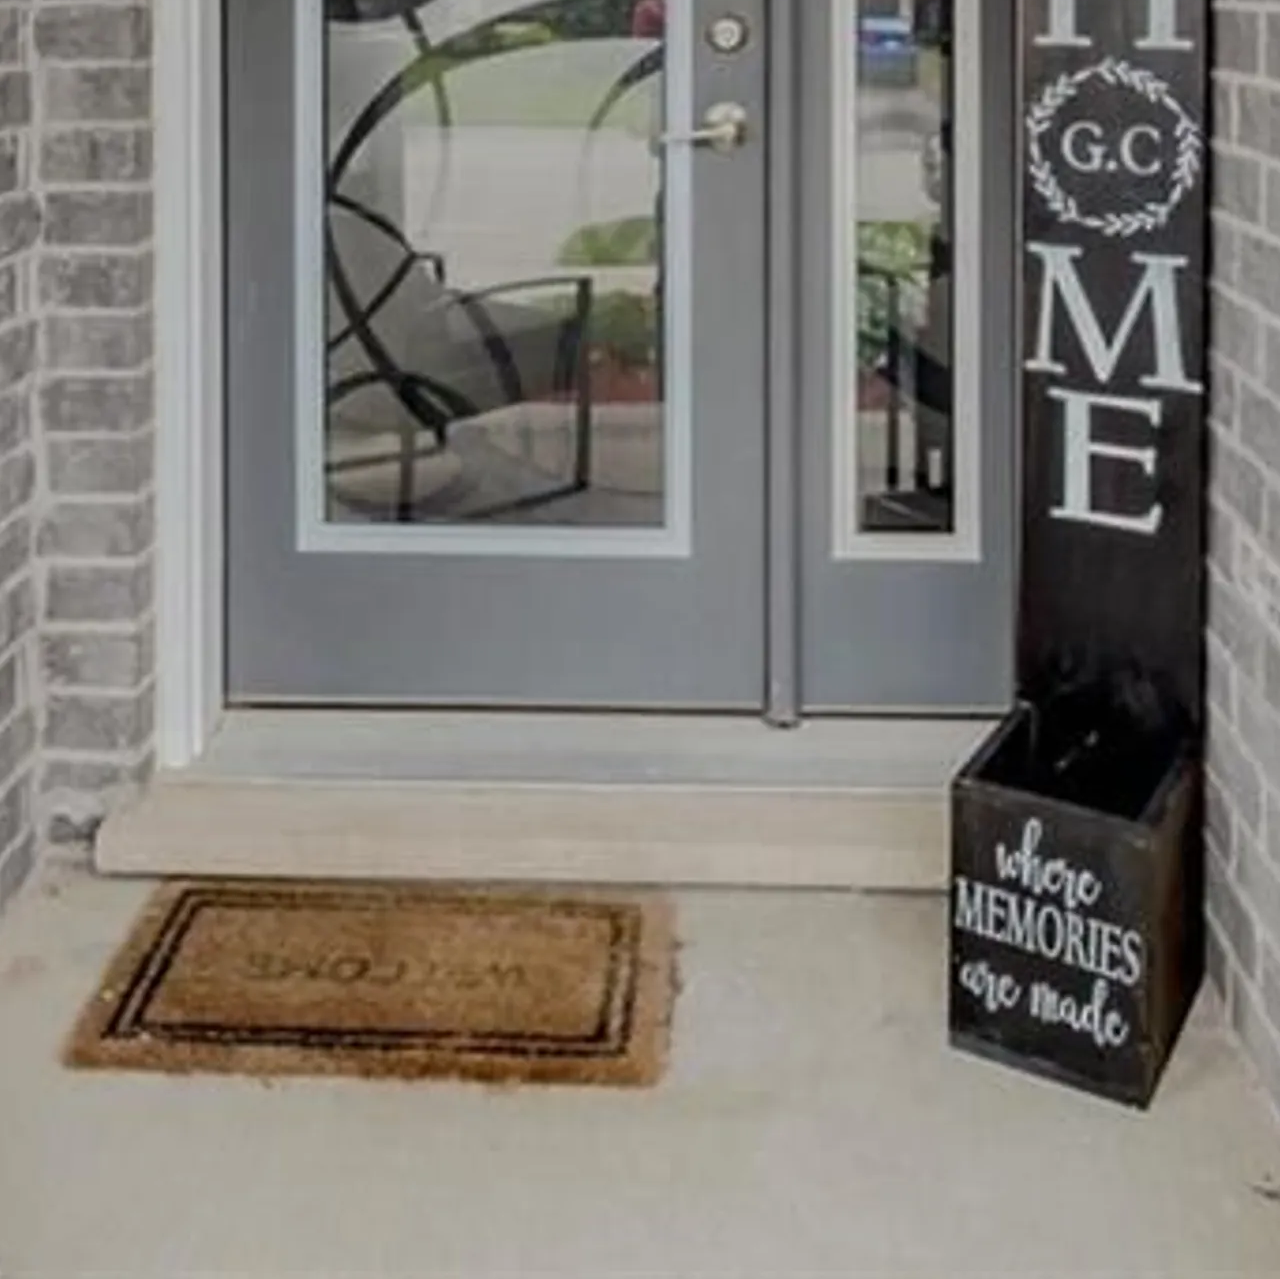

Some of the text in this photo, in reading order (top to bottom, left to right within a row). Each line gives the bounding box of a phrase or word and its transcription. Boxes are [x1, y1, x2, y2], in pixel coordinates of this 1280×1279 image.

[1060, 121, 1163, 176] G.C
[995, 817, 1102, 909] where
[953, 876, 1144, 986] MEMORIES
[959, 957, 1130, 1048] are made
